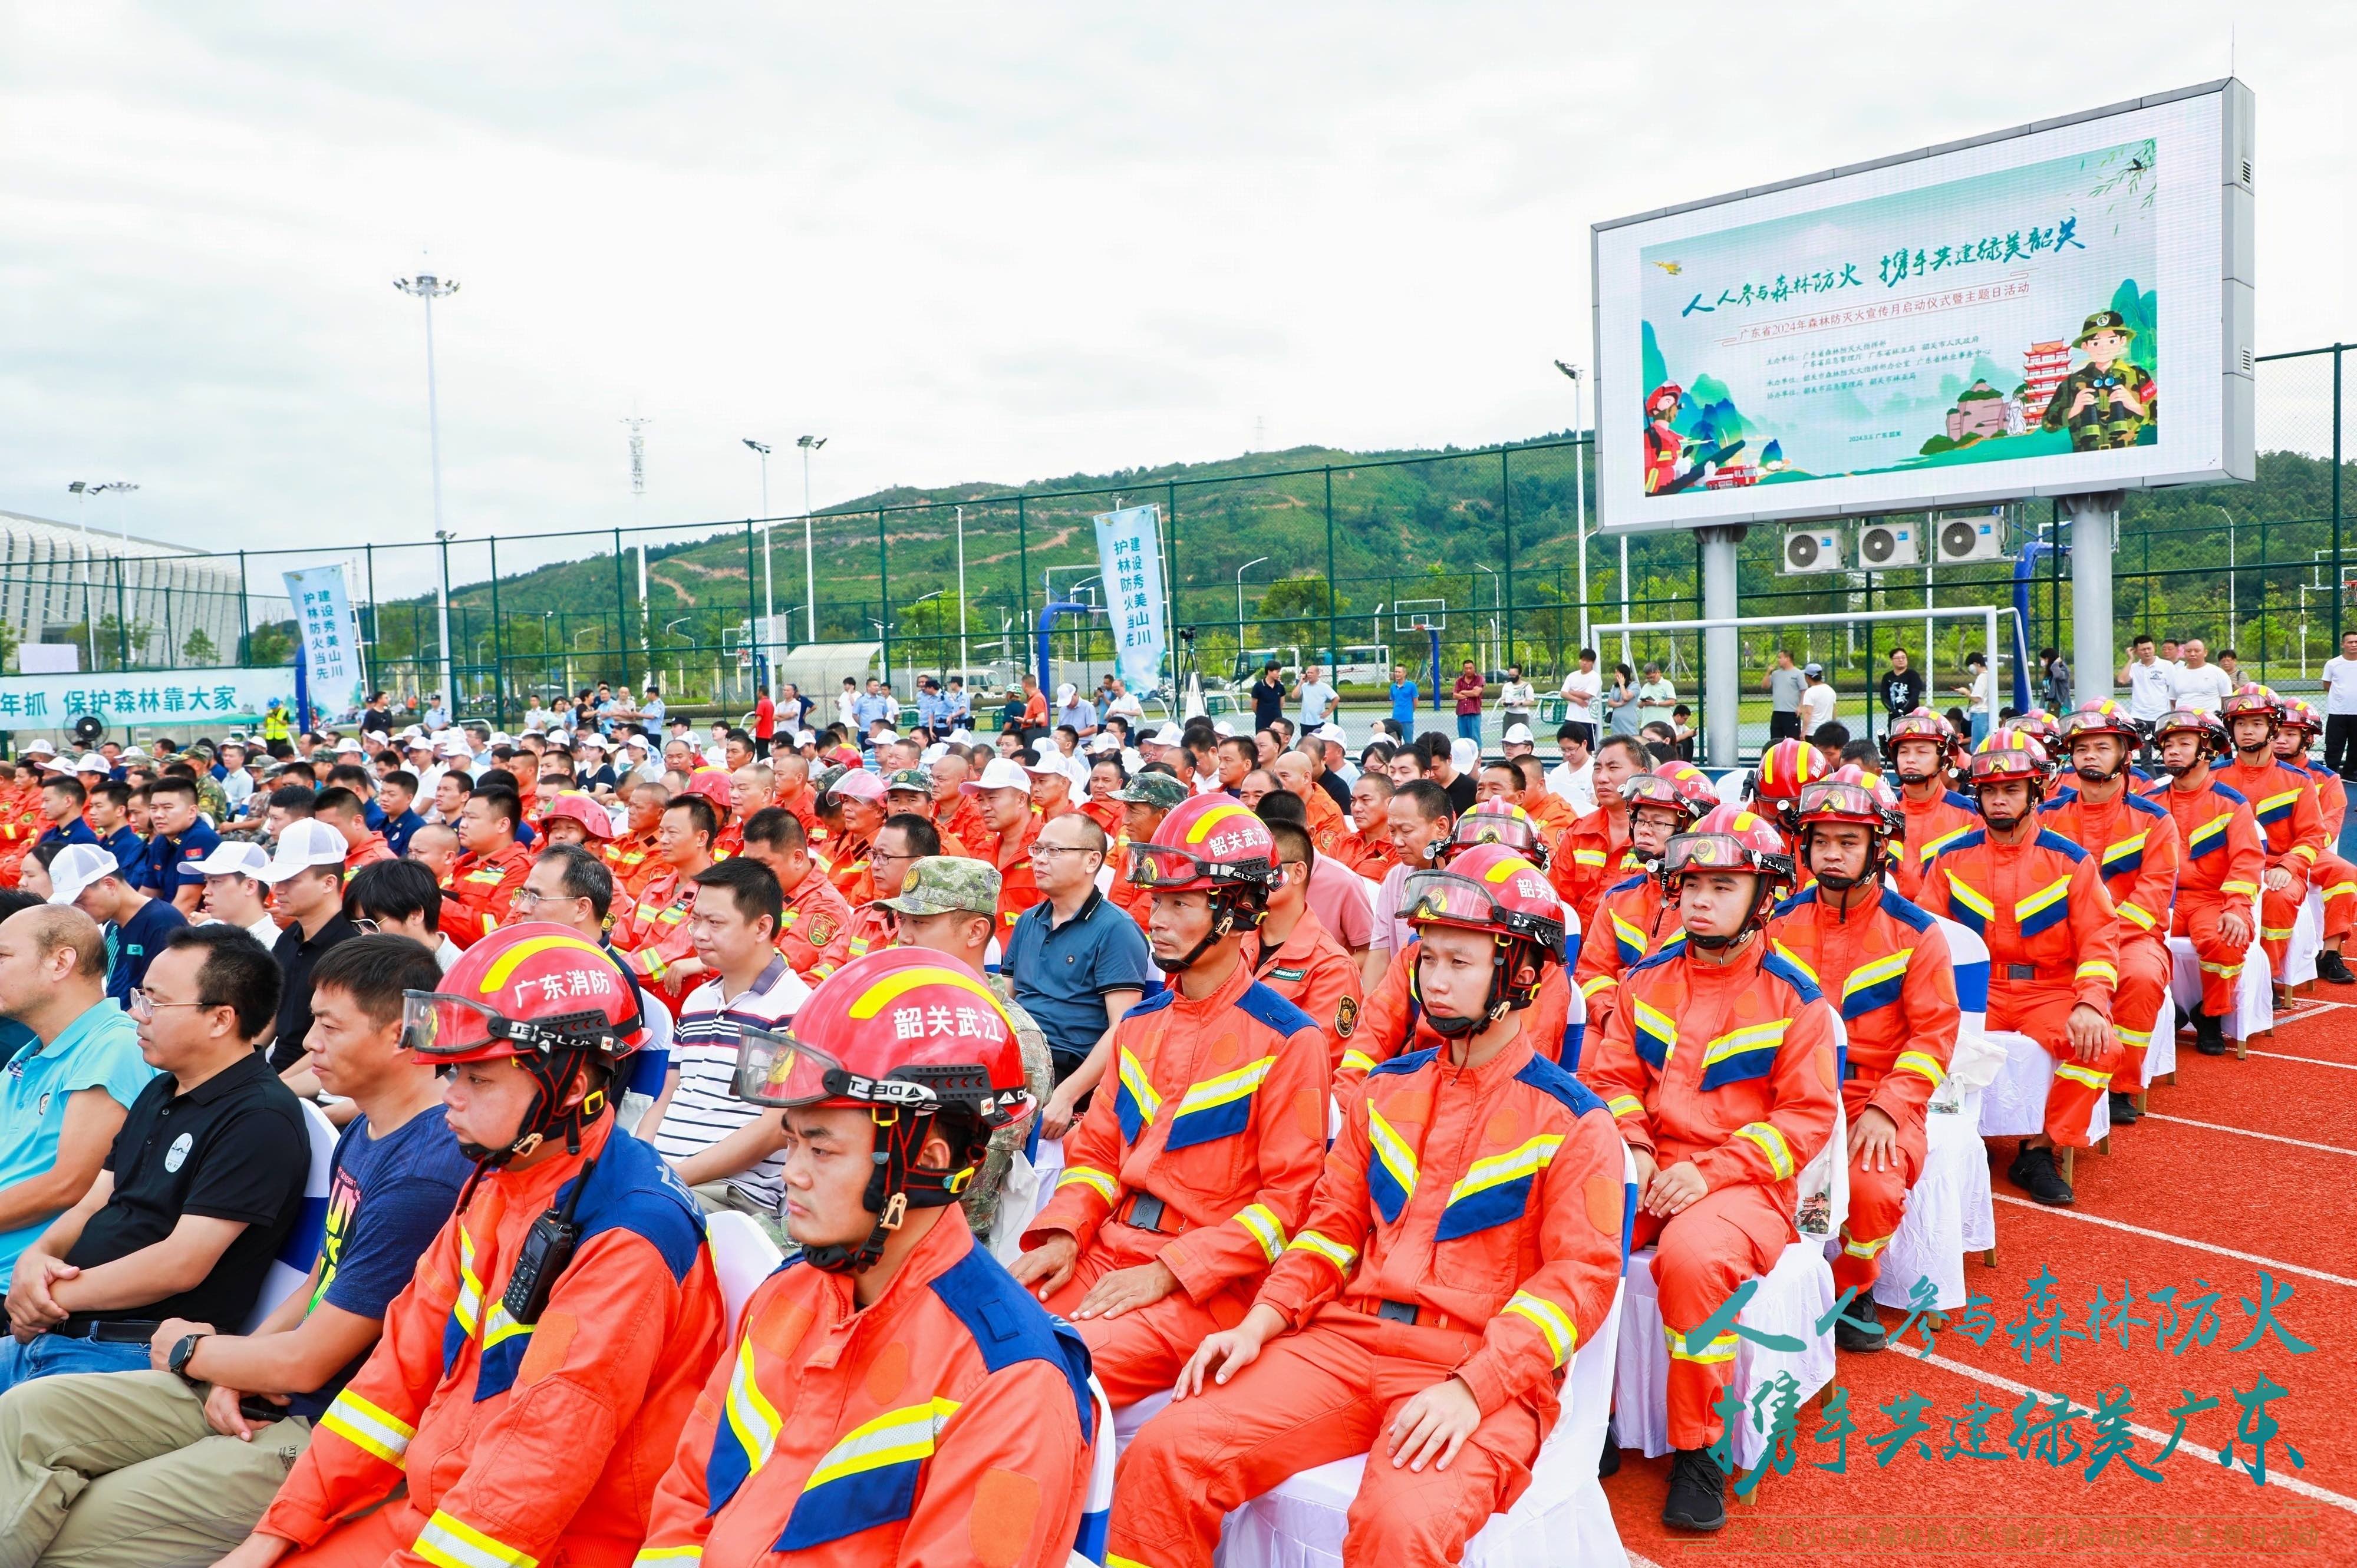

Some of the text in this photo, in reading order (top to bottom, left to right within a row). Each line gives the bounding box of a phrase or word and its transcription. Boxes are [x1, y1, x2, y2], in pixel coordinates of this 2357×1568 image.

[1682, 216, 2086, 317] 人人参与森林防火 携手共建绿美韶关
[1739, 282, 2030, 340] 广东省2024年森林防灭火宣传月启动仪式暨主题日活动
[1113, 539, 1135, 648] 护林防火当先
[1130, 537, 1151, 645] 建设秀美山川
[303, 592, 329, 680] 护林防火当先
[318, 590, 344, 677] 建设秀美山川
[0, 685, 237, 717] 年抓 保护森林靠大家
[1208, 827, 1270, 857] 韶关武江
[1233, 872, 1257, 882] ELTA
[513, 969, 611, 1009] 广东消防
[892, 1003, 1003, 1043] 韶关武江
